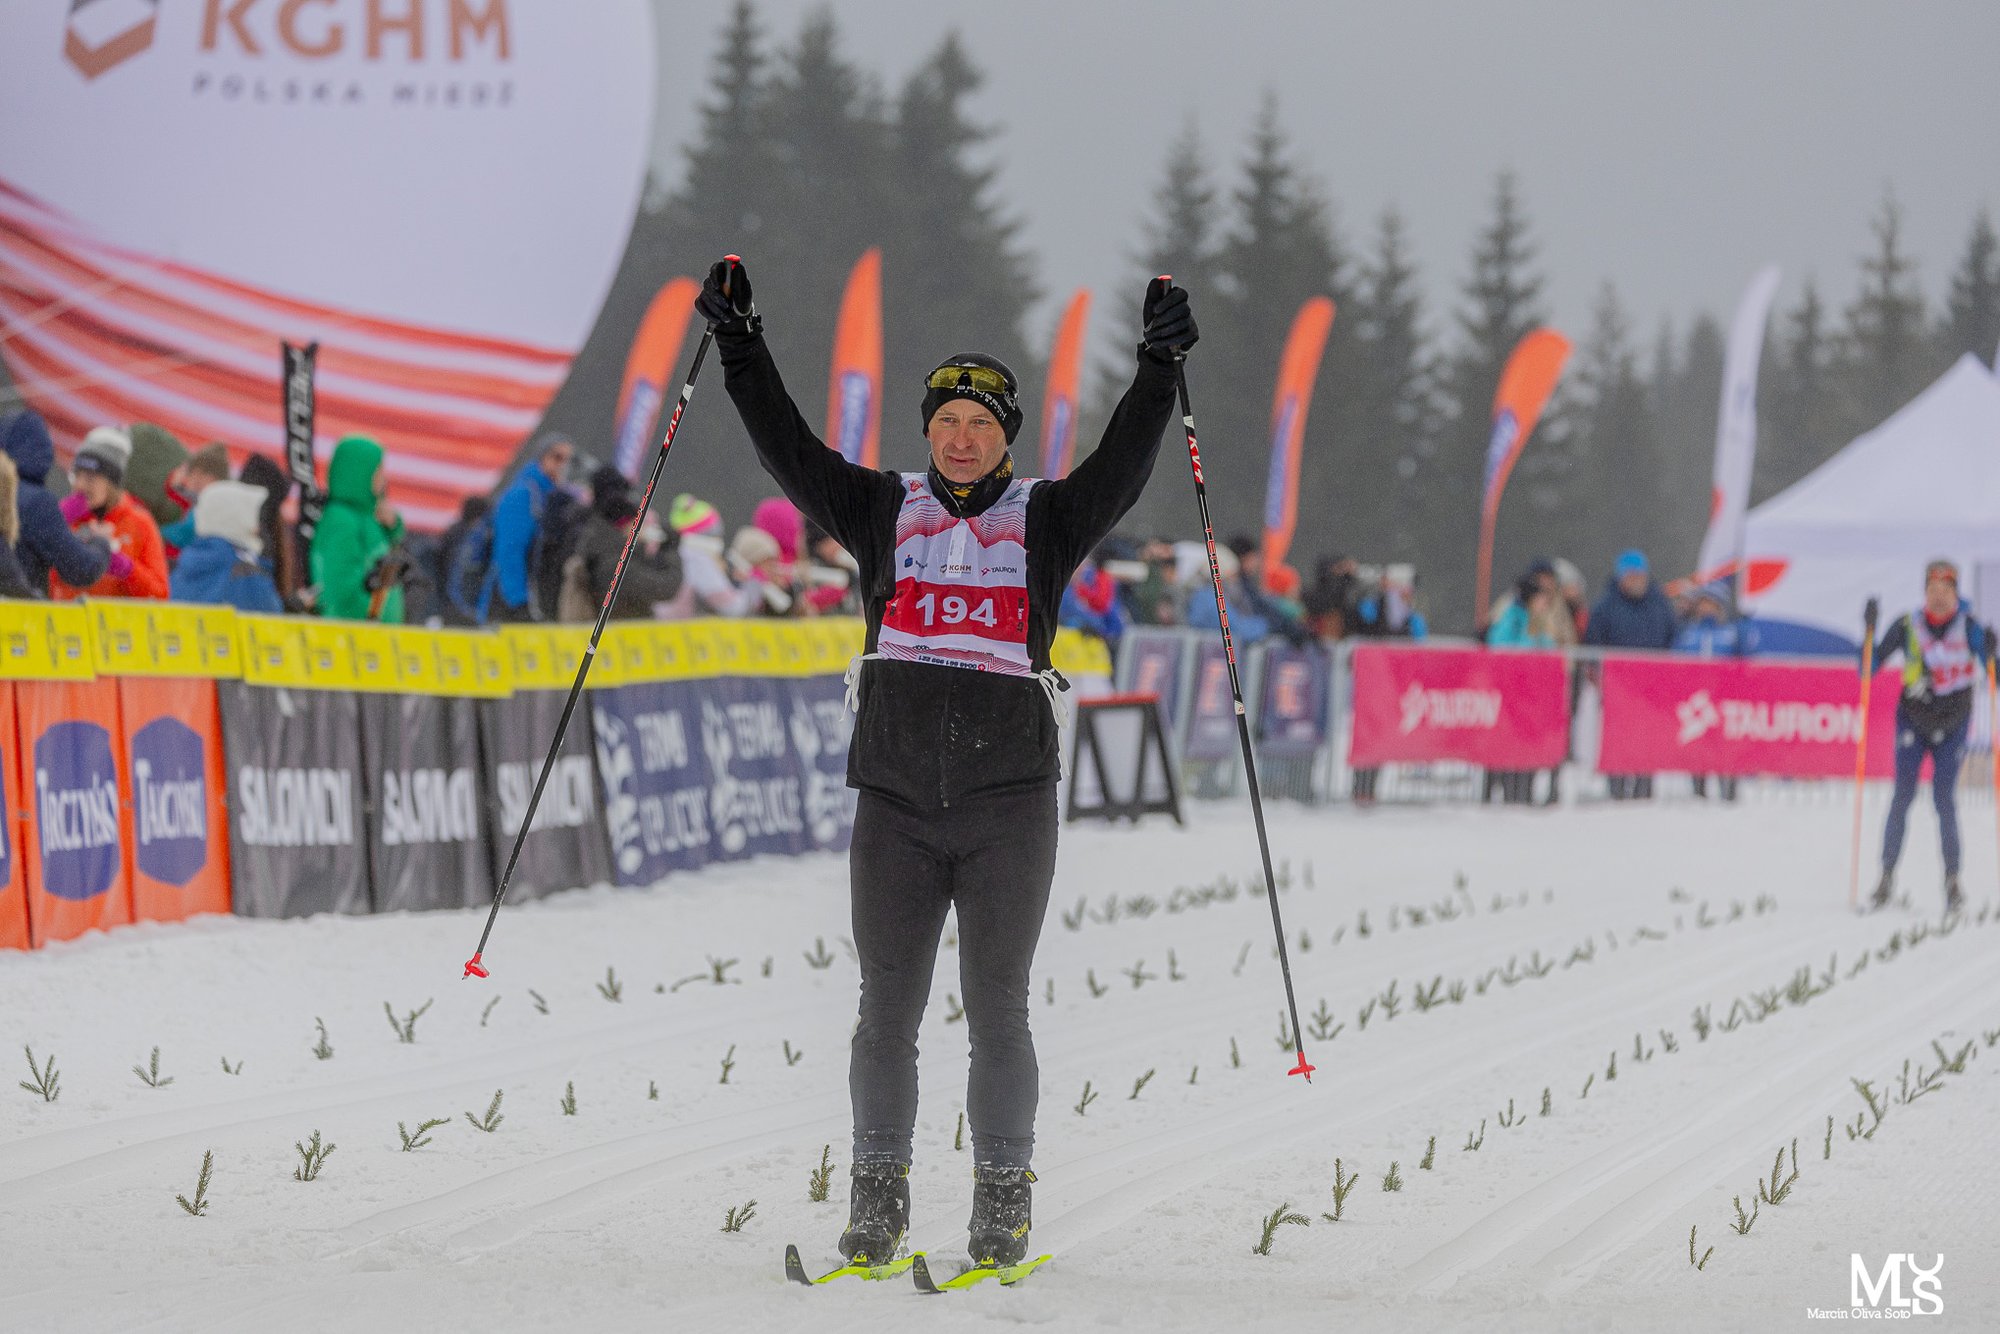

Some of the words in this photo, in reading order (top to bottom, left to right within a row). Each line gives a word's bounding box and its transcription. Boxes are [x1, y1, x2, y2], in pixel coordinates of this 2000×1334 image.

[199, 0, 512, 61] KGHM
[1189, 436, 1205, 484] KV+
[949, 564, 972, 572] KGHM
[991, 566, 1018, 574] TAURON
[915, 593, 998, 628] 194
[1721, 699, 1864, 743] TAURON
